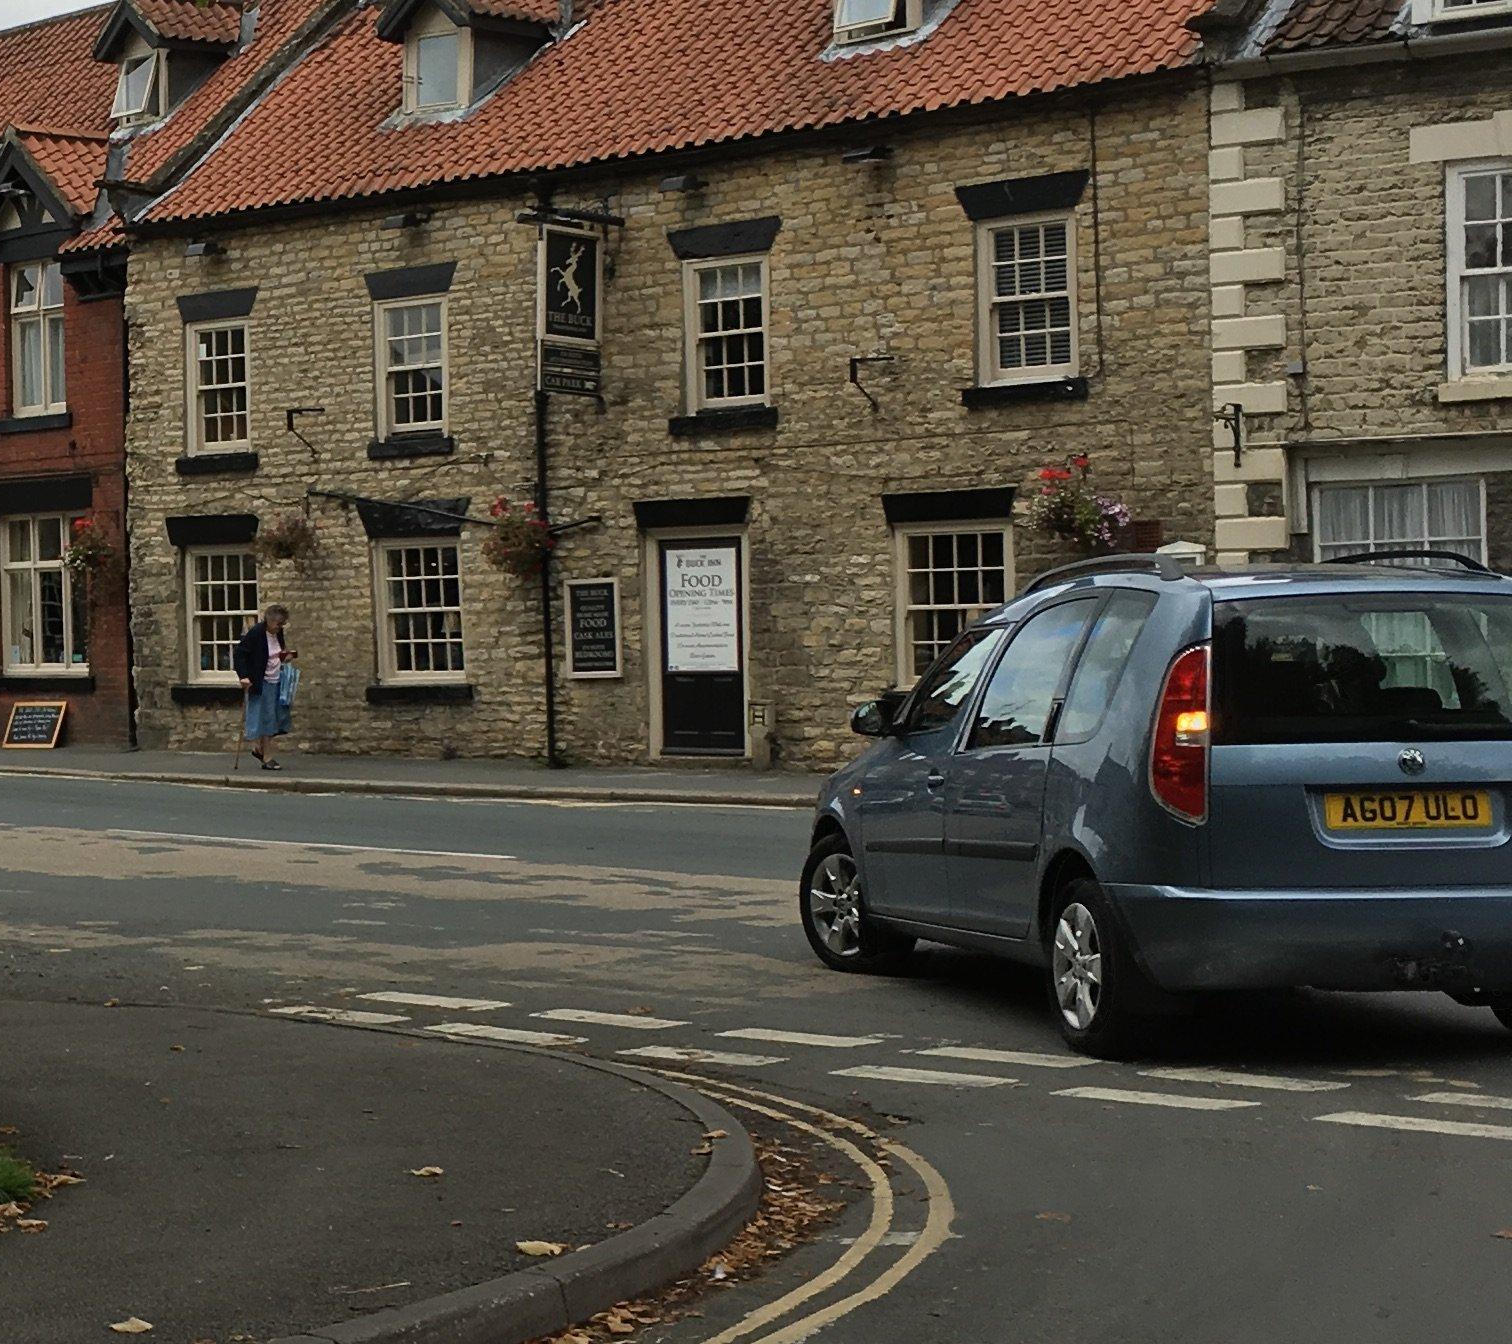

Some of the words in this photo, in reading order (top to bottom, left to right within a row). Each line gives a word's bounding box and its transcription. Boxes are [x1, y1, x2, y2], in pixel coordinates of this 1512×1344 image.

[681, 573, 723, 588] FOOD
[579, 618, 607, 628] FOOD
[1342, 795, 1415, 823] AG07
[1423, 794, 1480, 821] ULO
